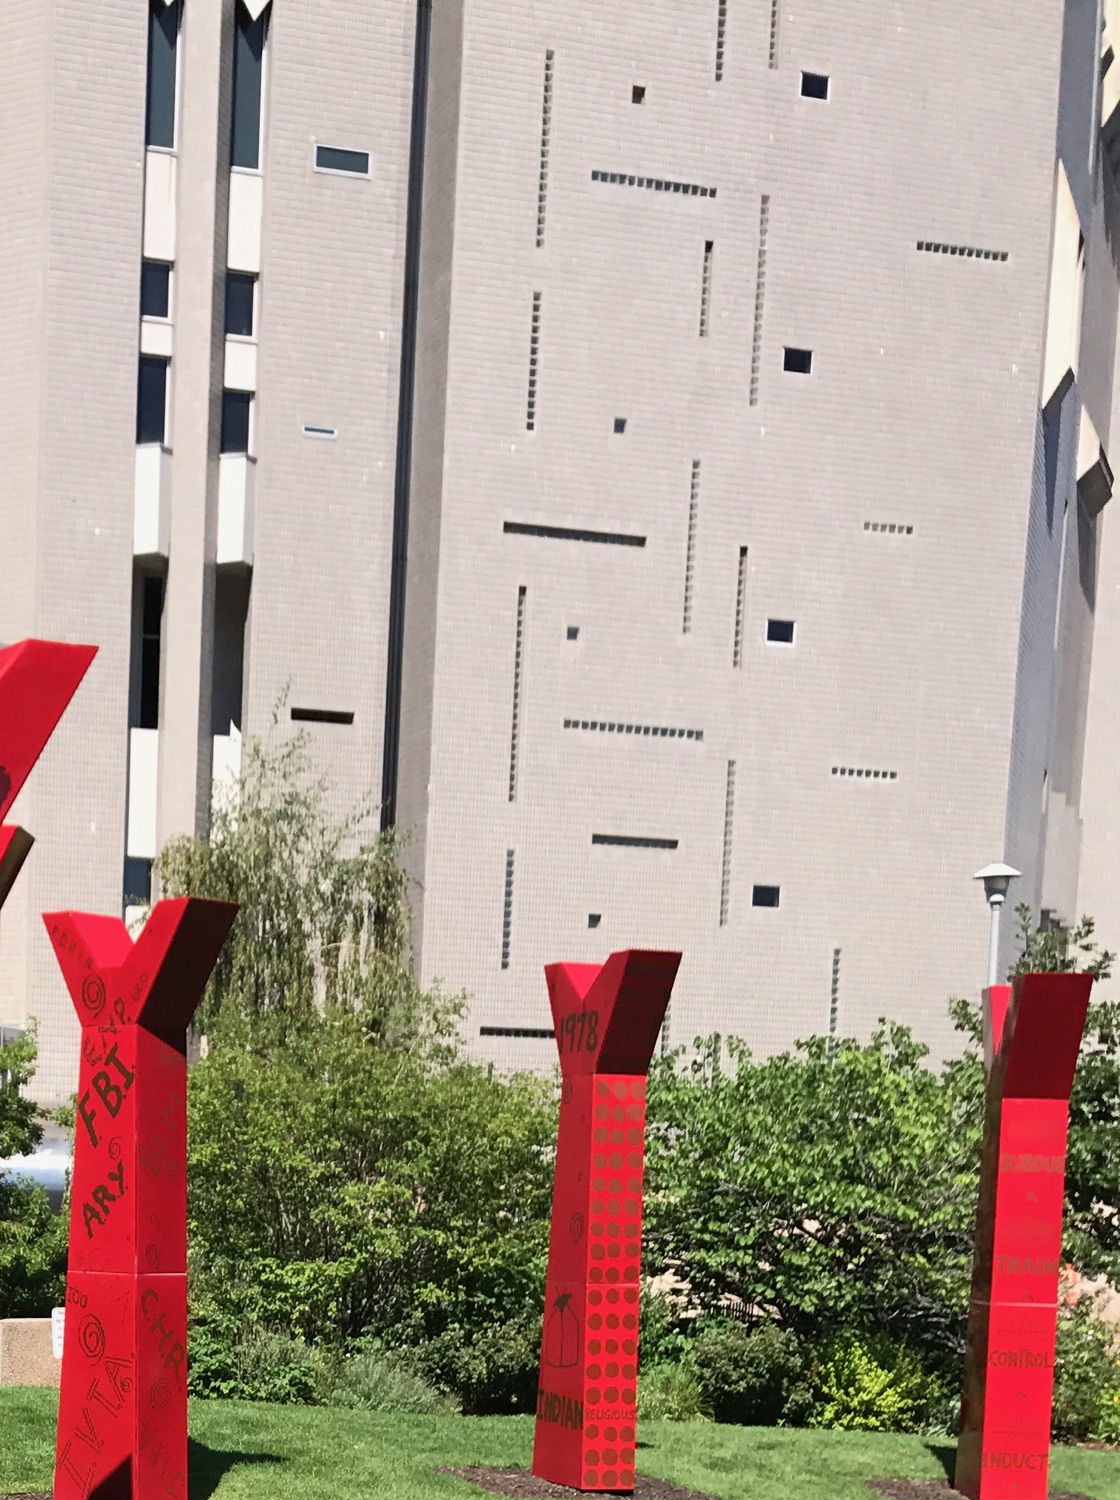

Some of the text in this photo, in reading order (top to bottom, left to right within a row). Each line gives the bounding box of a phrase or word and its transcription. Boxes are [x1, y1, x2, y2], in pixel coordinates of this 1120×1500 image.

[559, 1011, 599, 1055] 1978
[995, 1255, 1060, 1276] TRAIN
[989, 1348, 1054, 1368] CONTROL
[537, 1388, 584, 1430] INDIAN
[981, 1452, 1049, 1471] INDUCT
